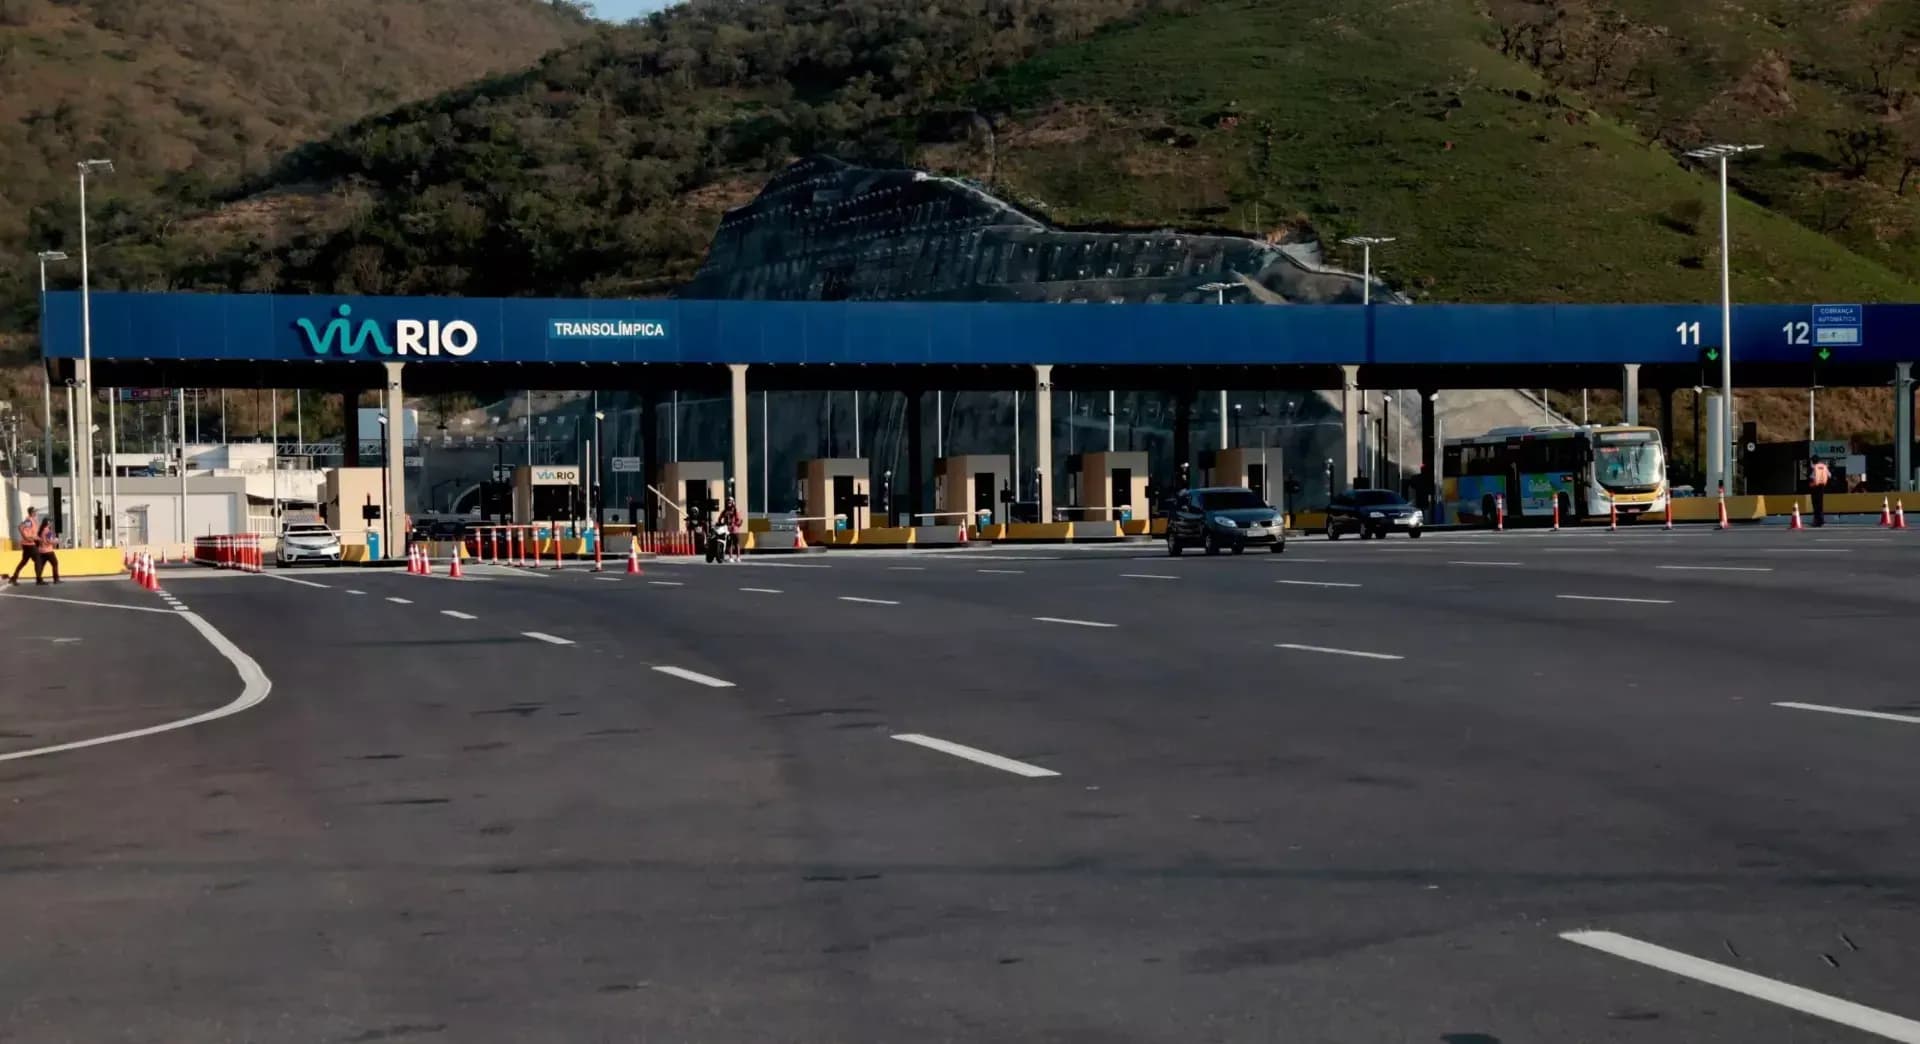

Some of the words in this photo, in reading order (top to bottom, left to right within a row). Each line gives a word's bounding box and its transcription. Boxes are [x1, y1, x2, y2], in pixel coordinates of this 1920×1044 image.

[553, 319, 665, 338] TRANSOLÍMPICA
[1676, 322, 1700, 345] 11
[1783, 322, 1810, 345] 12
